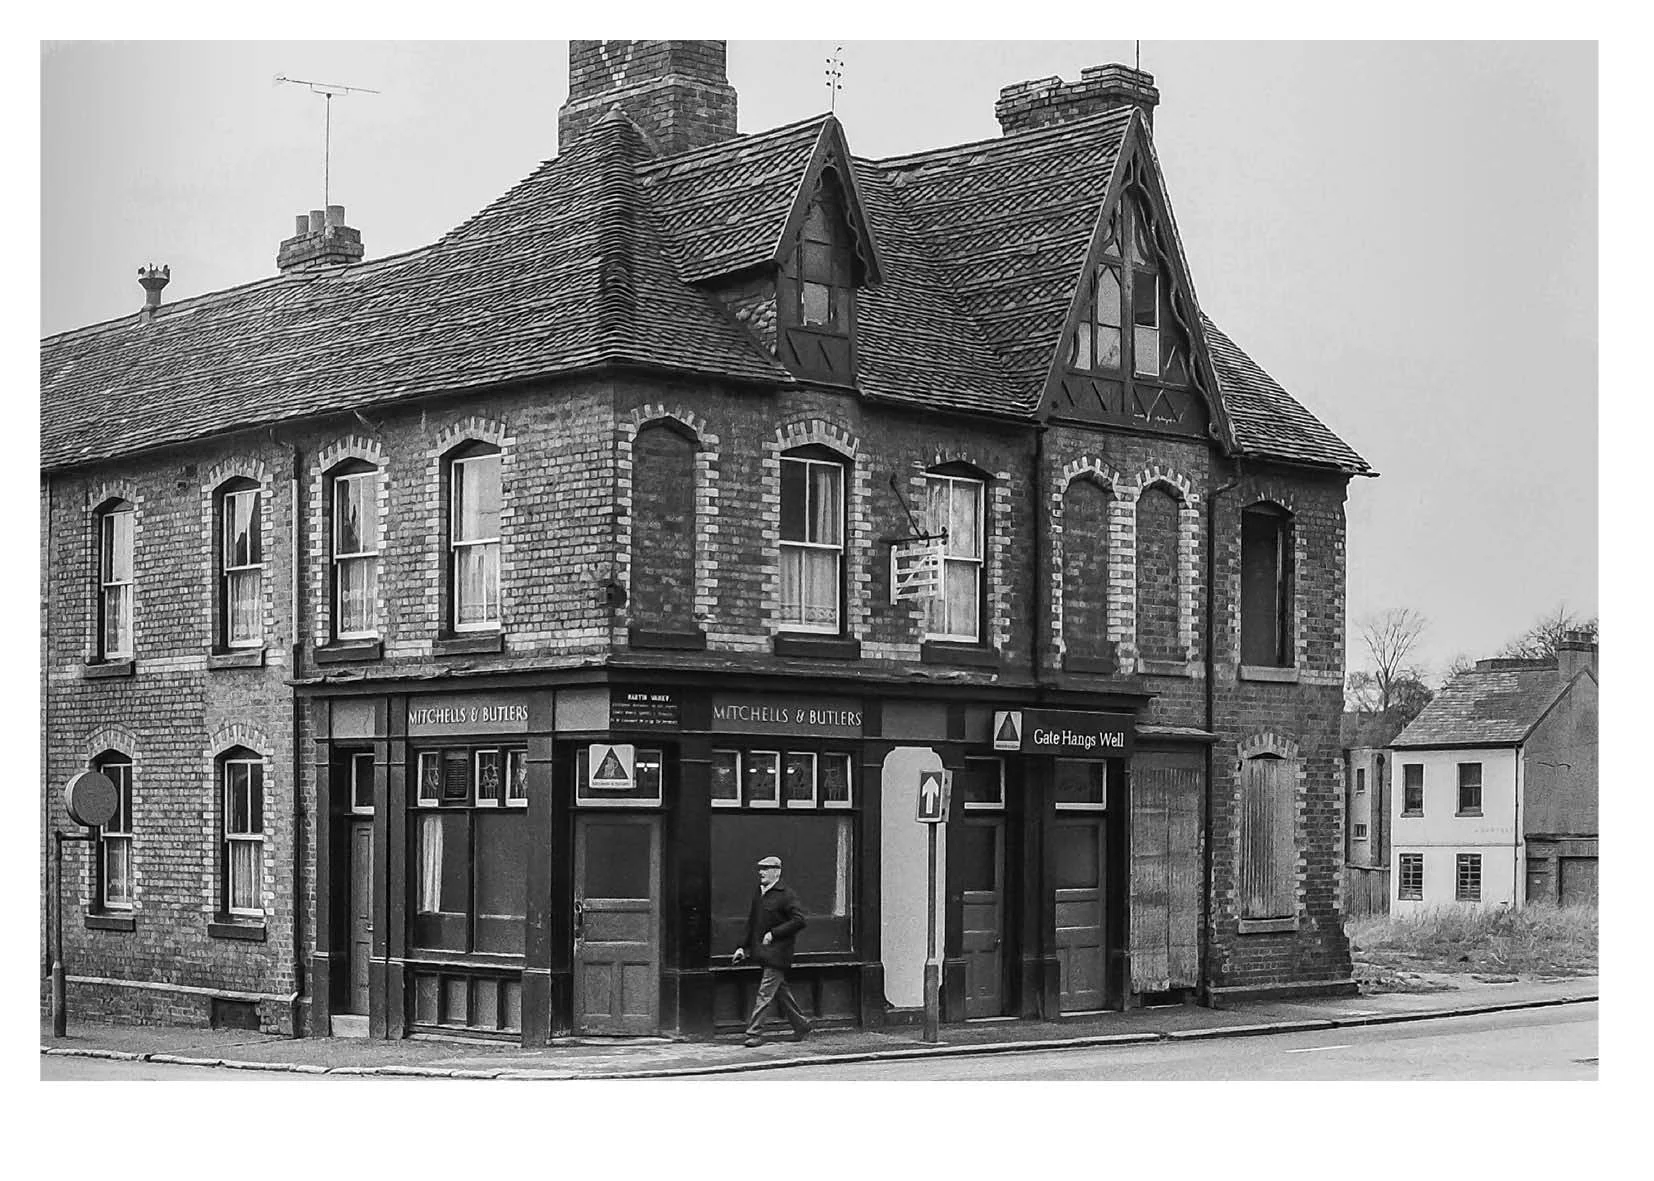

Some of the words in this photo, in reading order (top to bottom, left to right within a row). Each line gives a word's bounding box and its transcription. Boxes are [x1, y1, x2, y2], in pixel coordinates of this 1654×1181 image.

[408, 707, 466, 724] MITCHELLS
[470, 707, 480, 722] &
[483, 705, 528, 721] BUTLERS
[713, 705, 789, 722] MITCHELLS
[796, 709, 805, 724] &
[809, 709, 862, 726] BUTLERS
[1033, 729, 1060, 745] Gate
[1062, 730, 1096, 750] Hangs
[1099, 732, 1124, 747] Well
